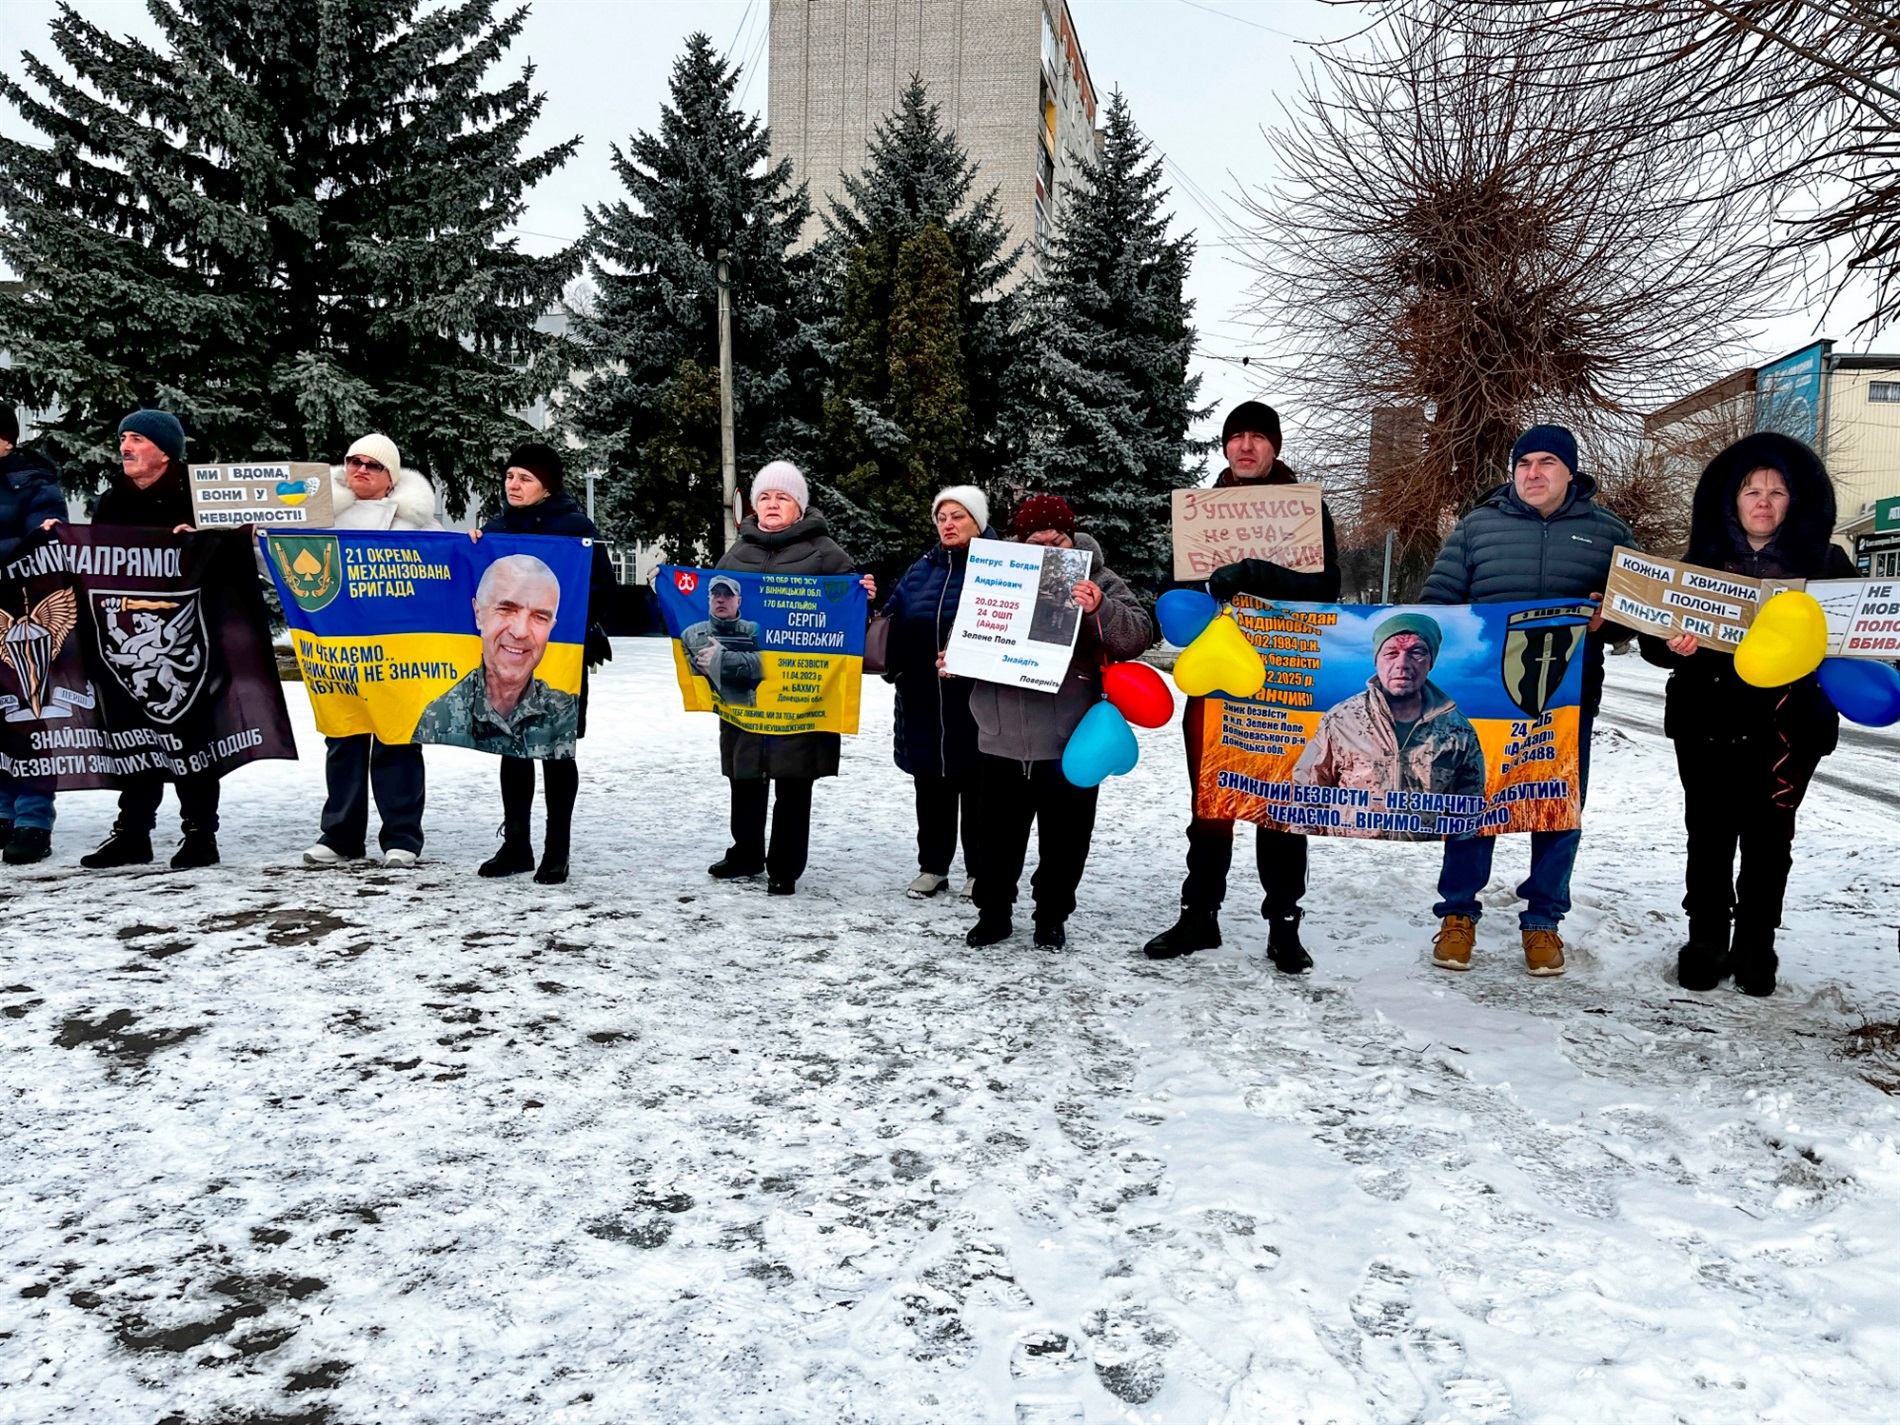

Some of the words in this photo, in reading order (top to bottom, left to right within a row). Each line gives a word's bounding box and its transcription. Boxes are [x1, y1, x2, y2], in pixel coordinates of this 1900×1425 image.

[196, 470, 218, 480] МИ
[233, 468, 288, 480] ВДОМА,
[202, 490, 242, 500] ВОНИ
[256, 489, 265, 499] У
[200, 510, 302, 523] НЕВІДОМОСТІ!
[344, 548, 363, 563] 21
[366, 548, 422, 563] ОКРЕМА
[346, 564, 451, 580] МЕХАНІЗОВАНА
[1009, 560, 1040, 571] Богдан
[974, 576, 1023, 590] Андрійович
[1622, 557, 1671, 582] КОЖНА
[1689, 574, 1758, 601] ХВИЛИНА
[348, 581, 415, 598] БРИГАДА
[759, 585, 765, 594] У
[1867, 586, 1892, 598] НЕ
[764, 599, 776, 608] 170
[776, 600, 817, 610] БАТАЛЬЙОН
[974, 597, 1020, 610] 20.02.2025
[1670, 593, 1726, 616] ПОЛОНІ
[788, 611, 826, 628] СЕРГІЙ
[977, 608, 988, 617] 24
[991, 611, 1013, 621] ОШП
[1619, 598, 1672, 626] МІНУС
[1684, 617, 1712, 635] РІК
[976, 620, 1009, 632] (Айдар)
[766, 629, 845, 648] КАРЧЕВСЬКИЙ
[962, 630, 993, 643] Зелене
[994, 635, 1017, 647] Поле
[299, 639, 313, 659] МИ
[796, 659, 829, 669] БЕЗВІСТИ
[1002, 655, 1039, 667] Знайдіть
[1268, 653, 1320, 669] безвісти
[363, 664, 385, 683] НЕ
[389, 662, 458, 680] ЗНАЧИТЬ
[792, 683, 821, 693] БАХМУТ
[1019, 675, 1060, 688] Поверніть
[1223, 702, 1246, 715] Зник
[1246, 718, 1279, 730] Зелене
[1280, 722, 1304, 733] Поле
[1510, 722, 1528, 737] 24
[30, 726, 103, 751] ЗНАЙДІТЬ
[1222, 724, 1290, 744] Волноваського
[1292, 737, 1306, 746] р-н
[12, 755, 86, 777] БЕЗВІСТИ
[217, 728, 263, 757] ОДШБ
[1221, 735, 1266, 754] Донецька
[1266, 744, 1286, 755] обл.
[1521, 746, 1555, 763] 3488
[1217, 771, 1291, 802] ЗНИКЛИЙ
[1293, 785, 1370, 807] БЕЗВІСТИ
[1386, 791, 1408, 811] НЕ
[1410, 792, 1488, 815] ЗНАЧИТЬ
[1435, 806, 1511, 834] ЛЮБИМО
